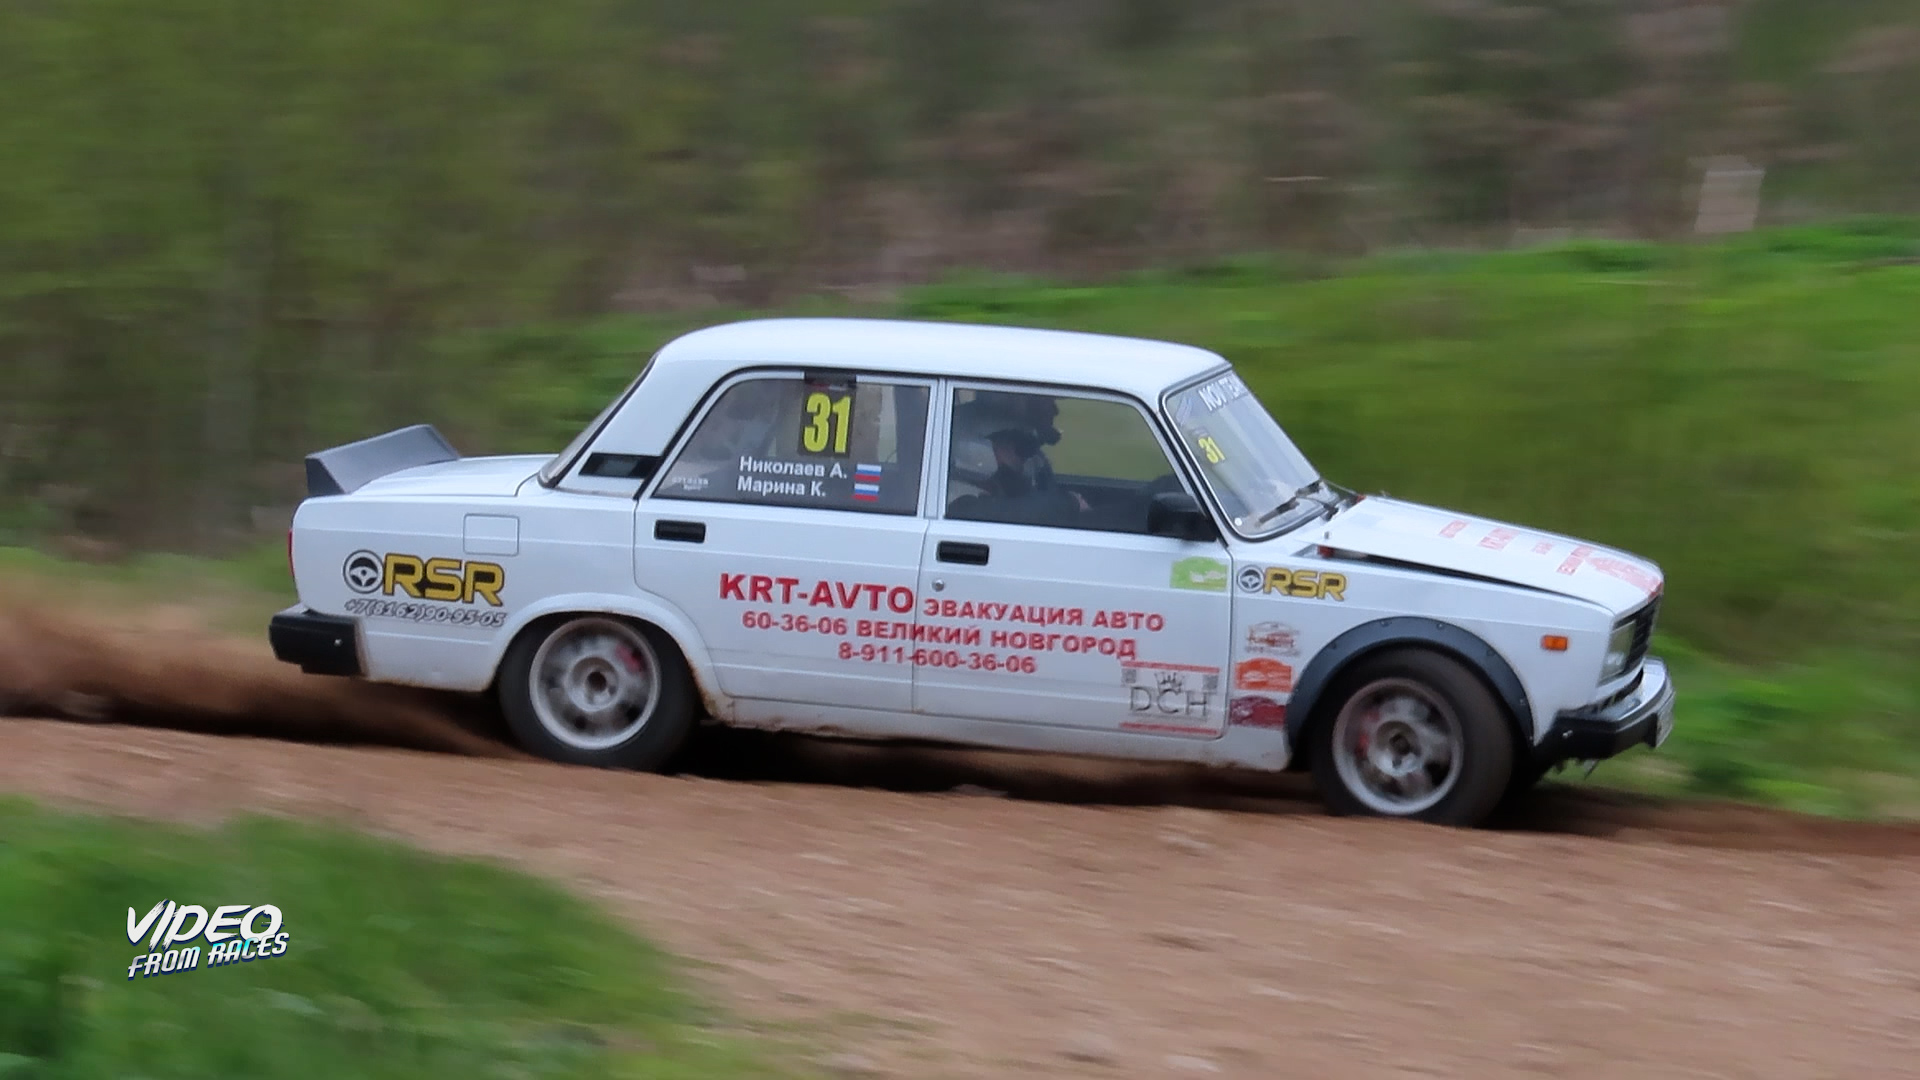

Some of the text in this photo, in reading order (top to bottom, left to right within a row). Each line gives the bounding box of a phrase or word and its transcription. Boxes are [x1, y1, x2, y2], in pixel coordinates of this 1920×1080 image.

[803, 392, 851, 453] 31
[1198, 436, 1226, 464] 31
[739, 456, 848, 479] Николаев А.
[737, 475, 826, 496] Марина К.
[383, 552, 505, 607] RSR
[719, 573, 915, 614] KRT-AVTO
[1263, 567, 1347, 601] RSR
[923, 598, 1164, 632] ЭВАКУАЦИЯ АВТО
[742, 610, 1136, 660] 60-36-06 ВЕЛИКИЙ НОВГОРОД
[838, 641, 1037, 674] 8-911-600-36-06
[1130, 686, 1209, 716] DCH
